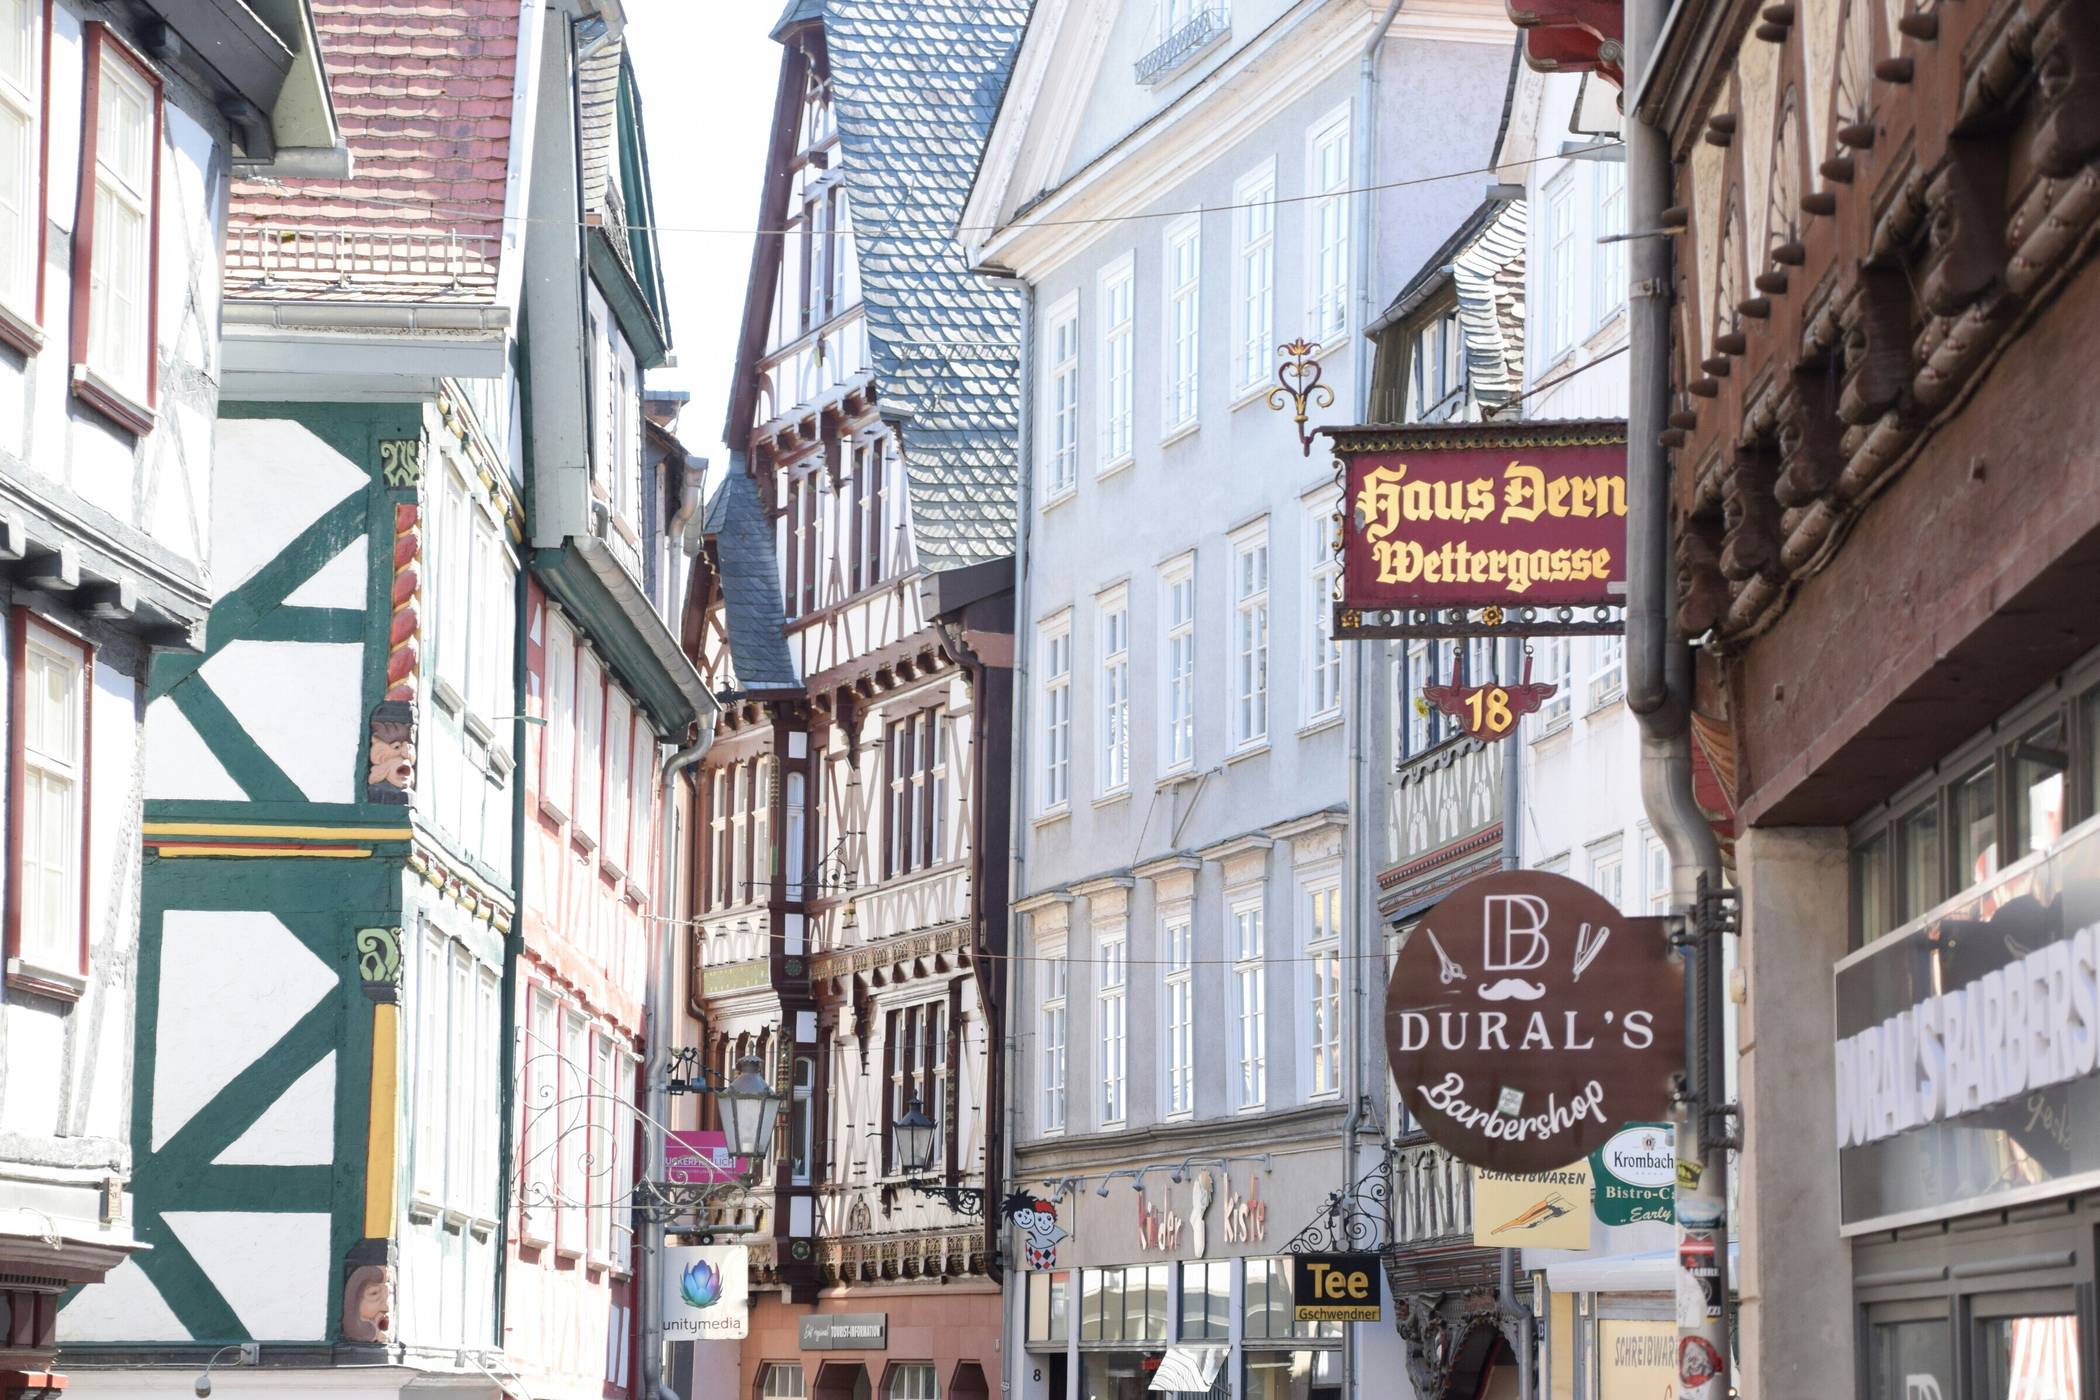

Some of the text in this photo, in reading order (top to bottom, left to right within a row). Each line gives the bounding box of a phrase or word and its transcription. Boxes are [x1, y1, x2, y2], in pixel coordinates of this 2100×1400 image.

[1356, 461, 1628, 542] Haus Dern
[1372, 540, 1611, 594] Wettergasse
[1465, 688, 1512, 732] 18
[1399, 1010, 1654, 1052] DURAL'S
[1944, 921, 2100, 1117] BARBERS
[1418, 1072, 1608, 1141] Barbershop
[1630, 1206, 1673, 1222] Early
[1307, 1263, 1369, 1299] Tee
[663, 1317, 741, 1334] unitymedia
[1299, 1307, 1377, 1320] Gschwendner
[1033, 1369, 1041, 1382] 8
